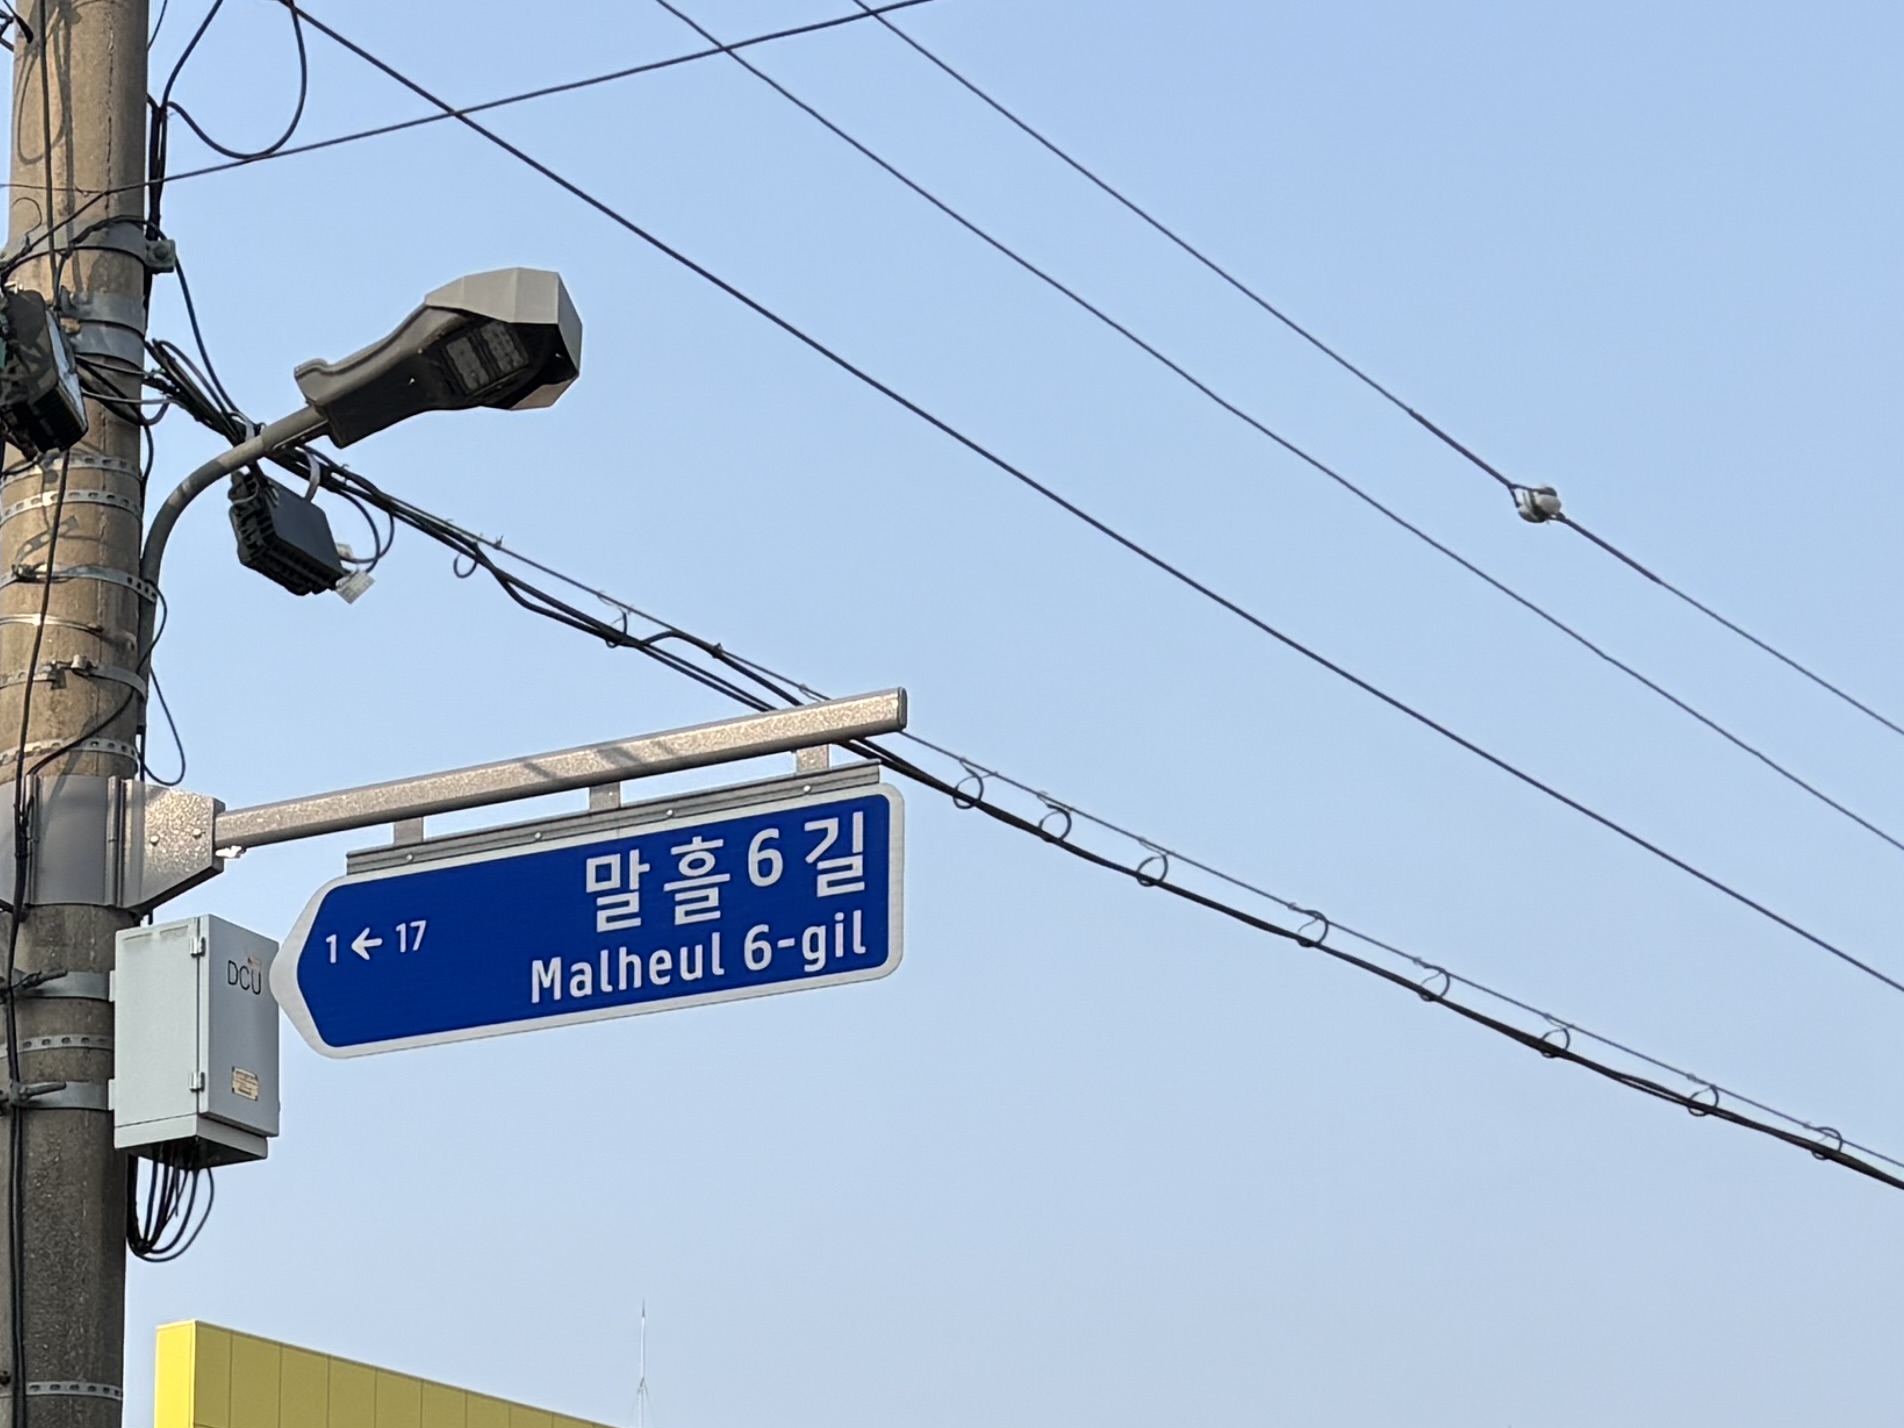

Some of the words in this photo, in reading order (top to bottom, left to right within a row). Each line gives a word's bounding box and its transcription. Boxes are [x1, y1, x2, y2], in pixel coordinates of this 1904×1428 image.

[325, 934, 338, 964] 1
[396, 920, 427, 954] 17
[530, 931, 725, 1004] Malheul
[742, 910, 867, 973] 6-gil
[227, 960, 262, 995] DCU
